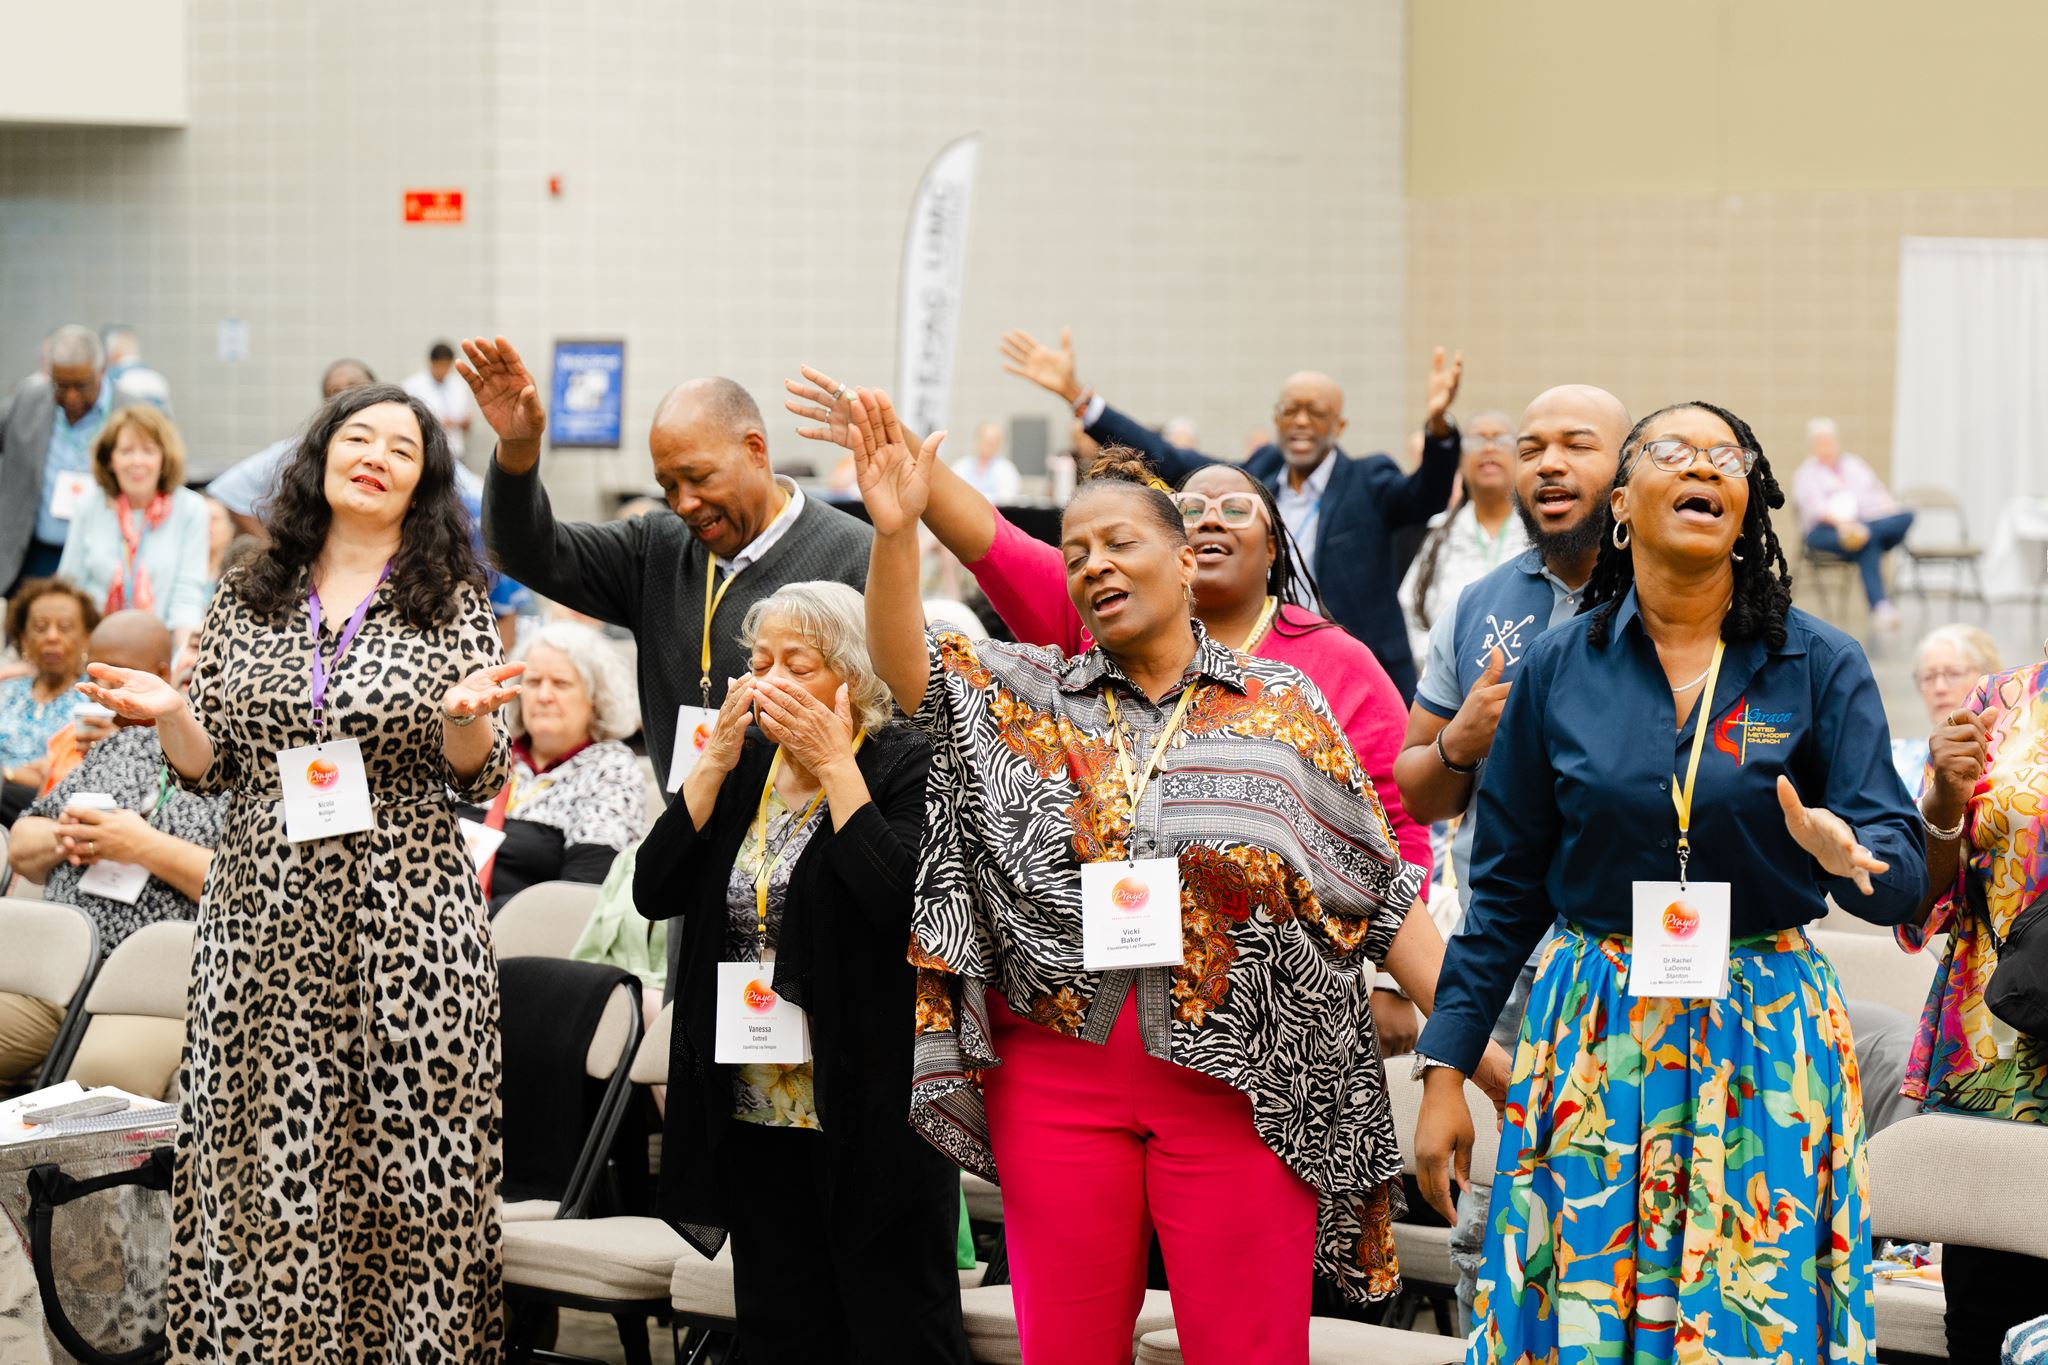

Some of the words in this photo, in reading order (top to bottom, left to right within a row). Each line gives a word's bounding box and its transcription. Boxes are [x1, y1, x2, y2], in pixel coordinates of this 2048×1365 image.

[1738, 708, 1792, 725] Grace
[309, 769, 337, 785] Prayer
[1113, 889, 1146, 906] Prayer
[1663, 913, 1697, 934] Prayer
[1120, 936, 1142, 944] Baker
[745, 990, 775, 1008] Prayer
[748, 1025, 772, 1033] Vanessa
